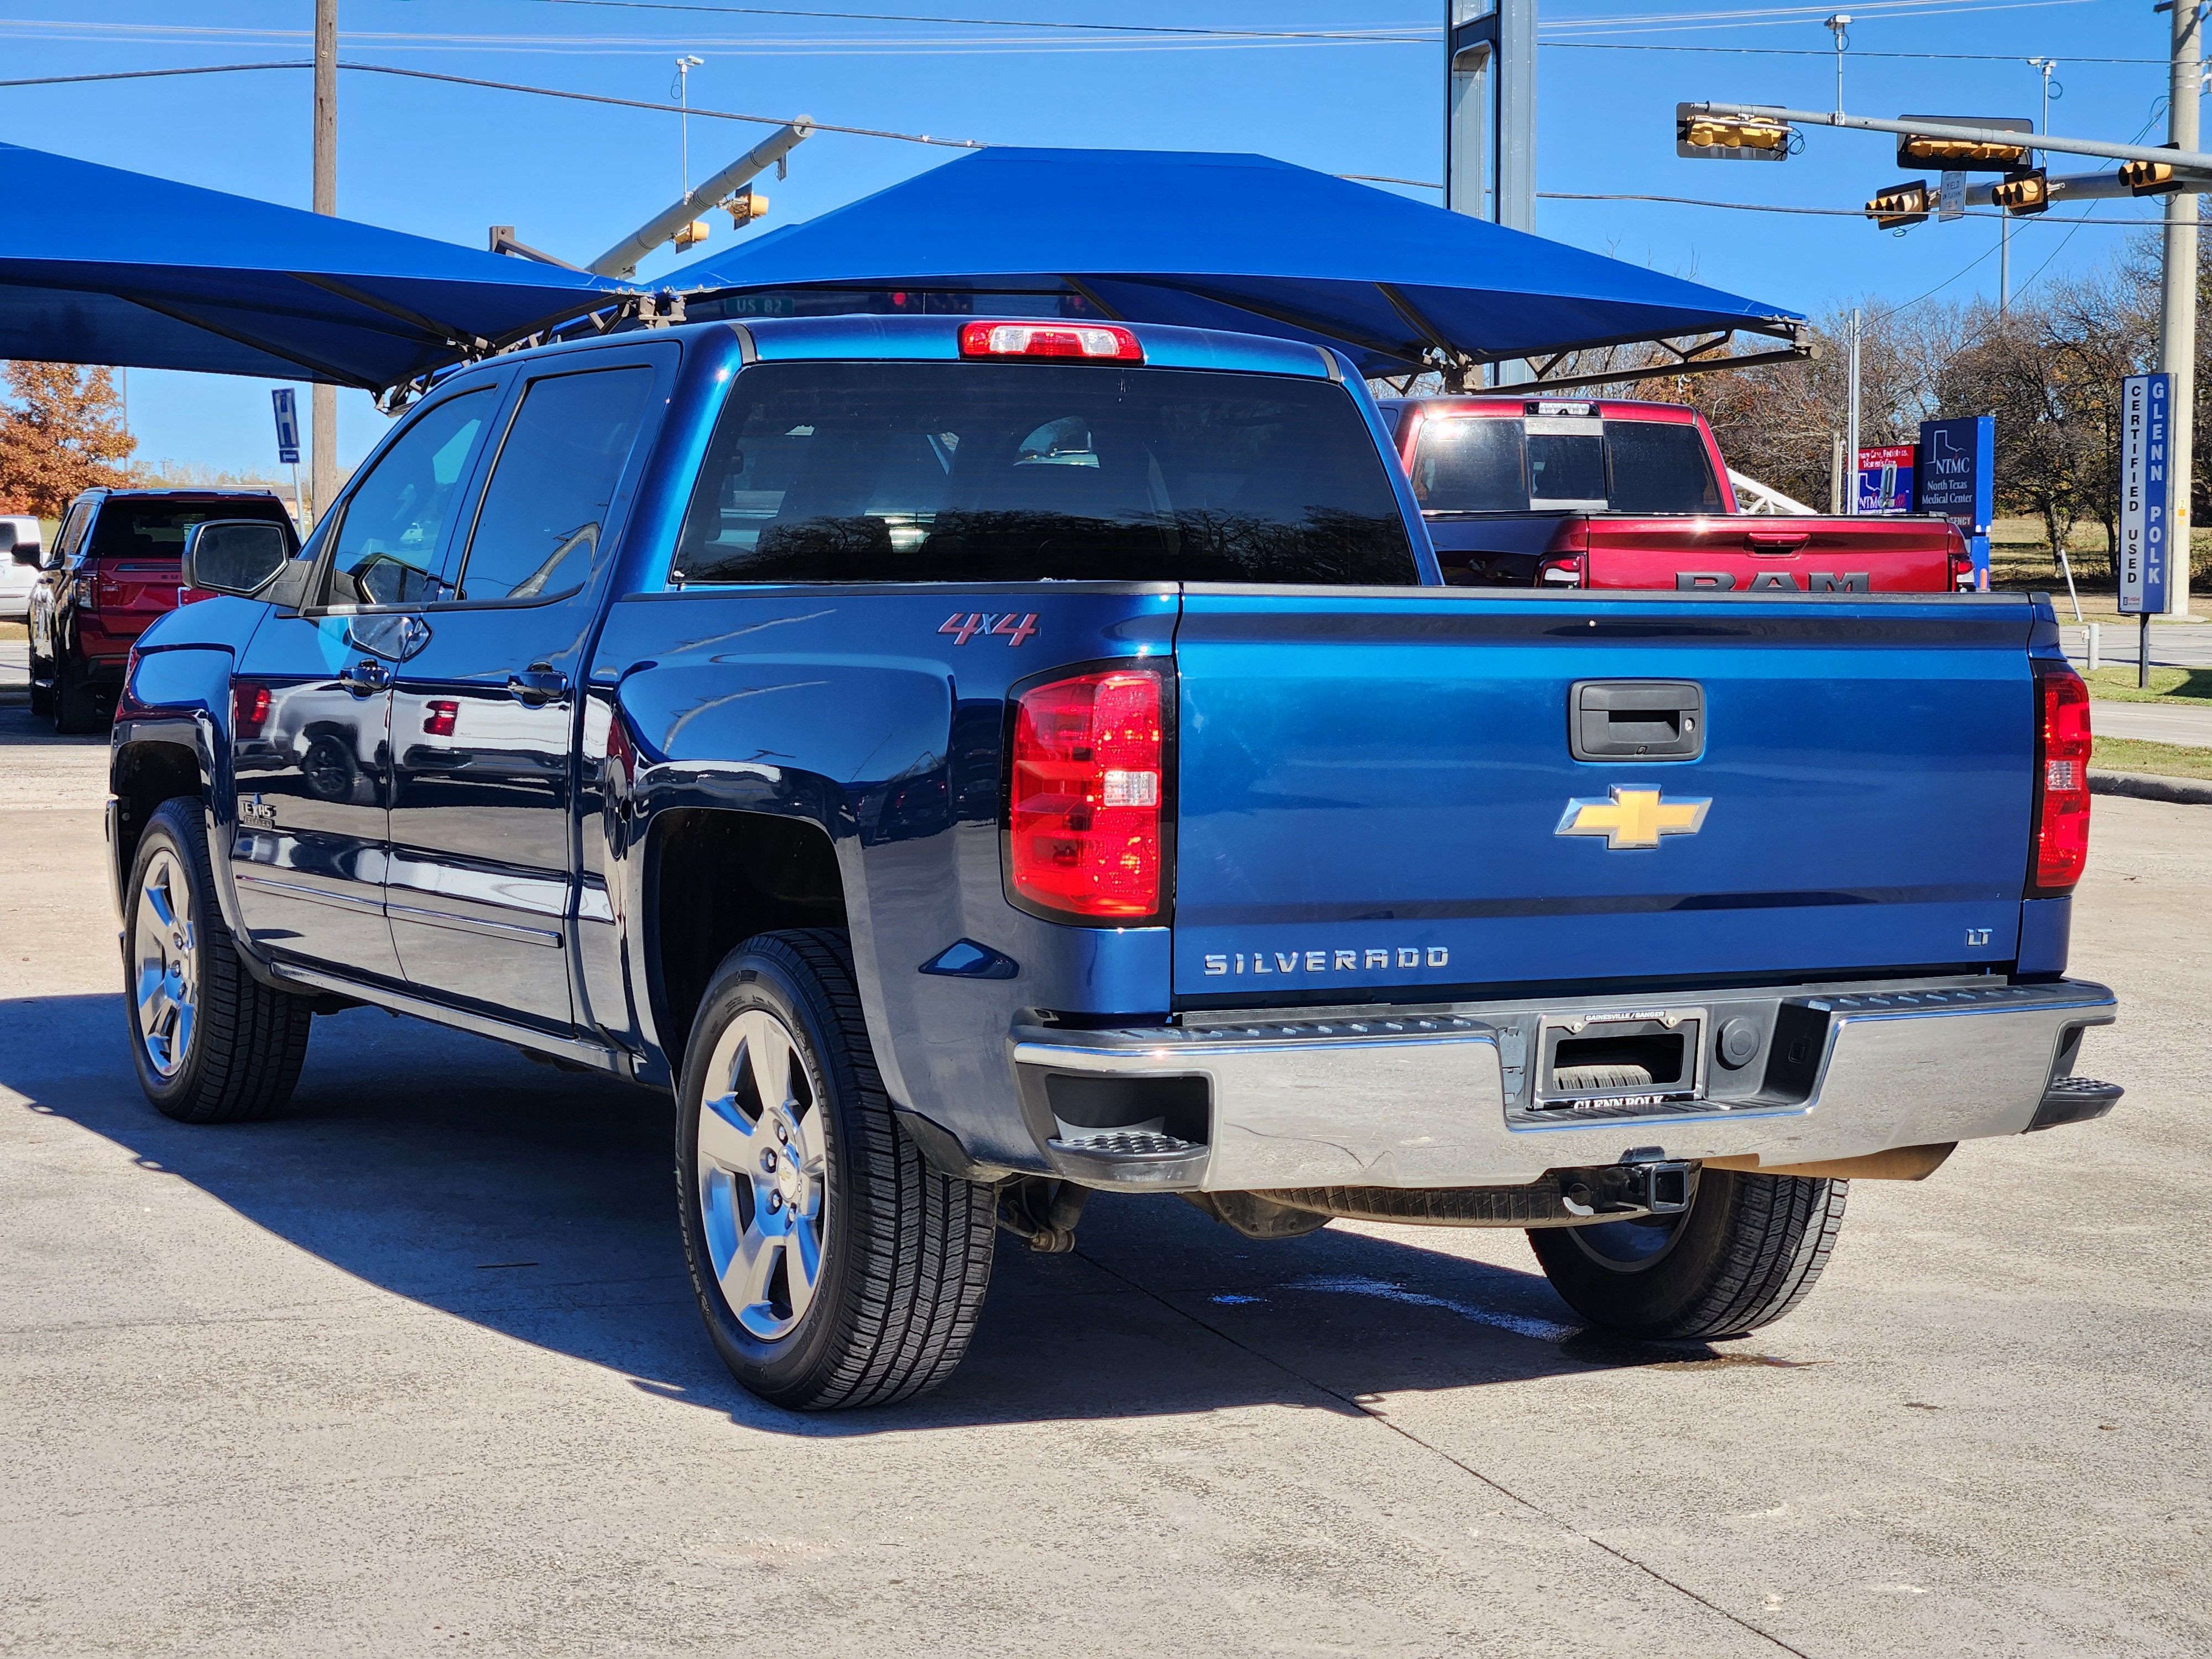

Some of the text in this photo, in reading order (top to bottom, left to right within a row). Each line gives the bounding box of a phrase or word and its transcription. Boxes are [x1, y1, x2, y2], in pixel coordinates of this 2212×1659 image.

[737, 299, 756, 312] US
[275, 392, 296, 445] H
[2129, 385, 2141, 512] CERTIFIED
[1936, 457, 1970, 474] NTMC
[1927, 479, 1968, 491] North Texas
[2148, 382, 2164, 584] GLENN POLK
[1922, 492, 1973, 504] Medical Center
[2127, 529, 2138, 583] USED
[1676, 572, 1869, 591] RAM
[1966, 928, 1993, 946] LT
[1204, 946, 1449, 975] SILVERADO
[1574, 1097, 1624, 1109] GLENN
[807, 1048, 837, 1185] MICHELIN
